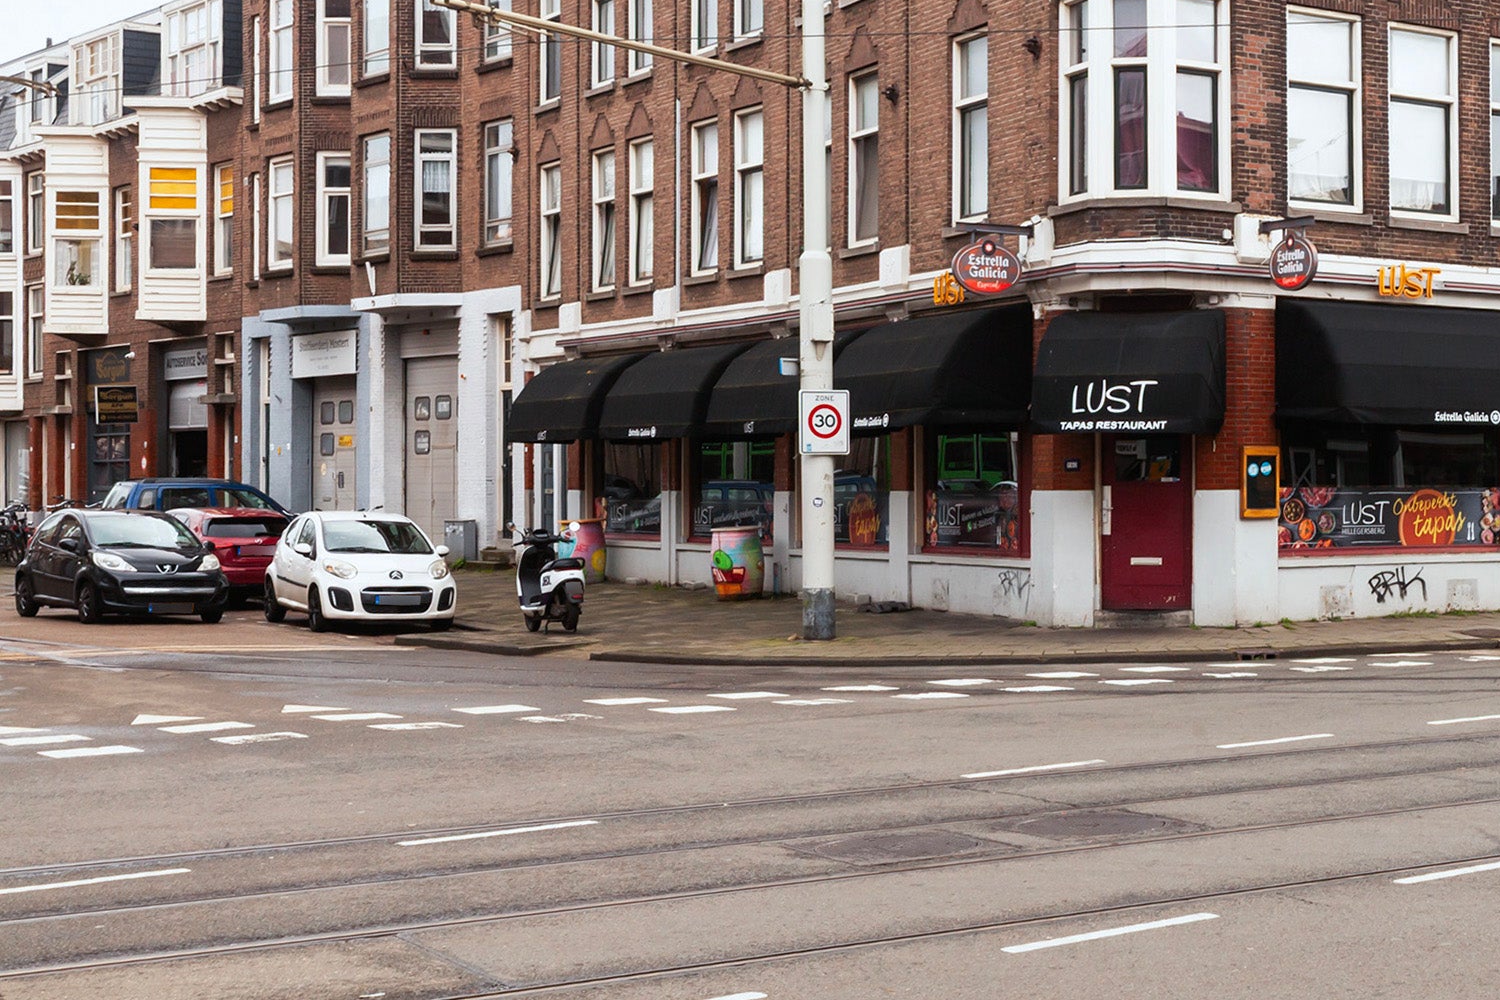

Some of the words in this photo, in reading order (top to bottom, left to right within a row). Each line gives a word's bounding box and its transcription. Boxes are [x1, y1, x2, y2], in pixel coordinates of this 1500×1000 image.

[968, 253, 1009, 267] Estrella
[1277, 250, 1305, 263] Estrella
[969, 265, 1007, 279] Galicia
[1277, 260, 1303, 274] Galicia
[1378, 264, 1441, 298] LUST
[1072, 379, 1159, 414] LUST
[814, 414, 836, 428] 30
[1434, 411, 1463, 422] Estrella
[1463, 411, 1489, 422] Galicia
[1060, 421, 1093, 430] TAPAS
[1096, 421, 1167, 430] RESTAURANT
[1393, 491, 1458, 516] Onbeperkt
[939, 503, 963, 526] LUST
[1342, 500, 1390, 526] LUST
[1341, 526, 1385, 536] HILLEGERSBERG
[1413, 511, 1465, 544] tapas
